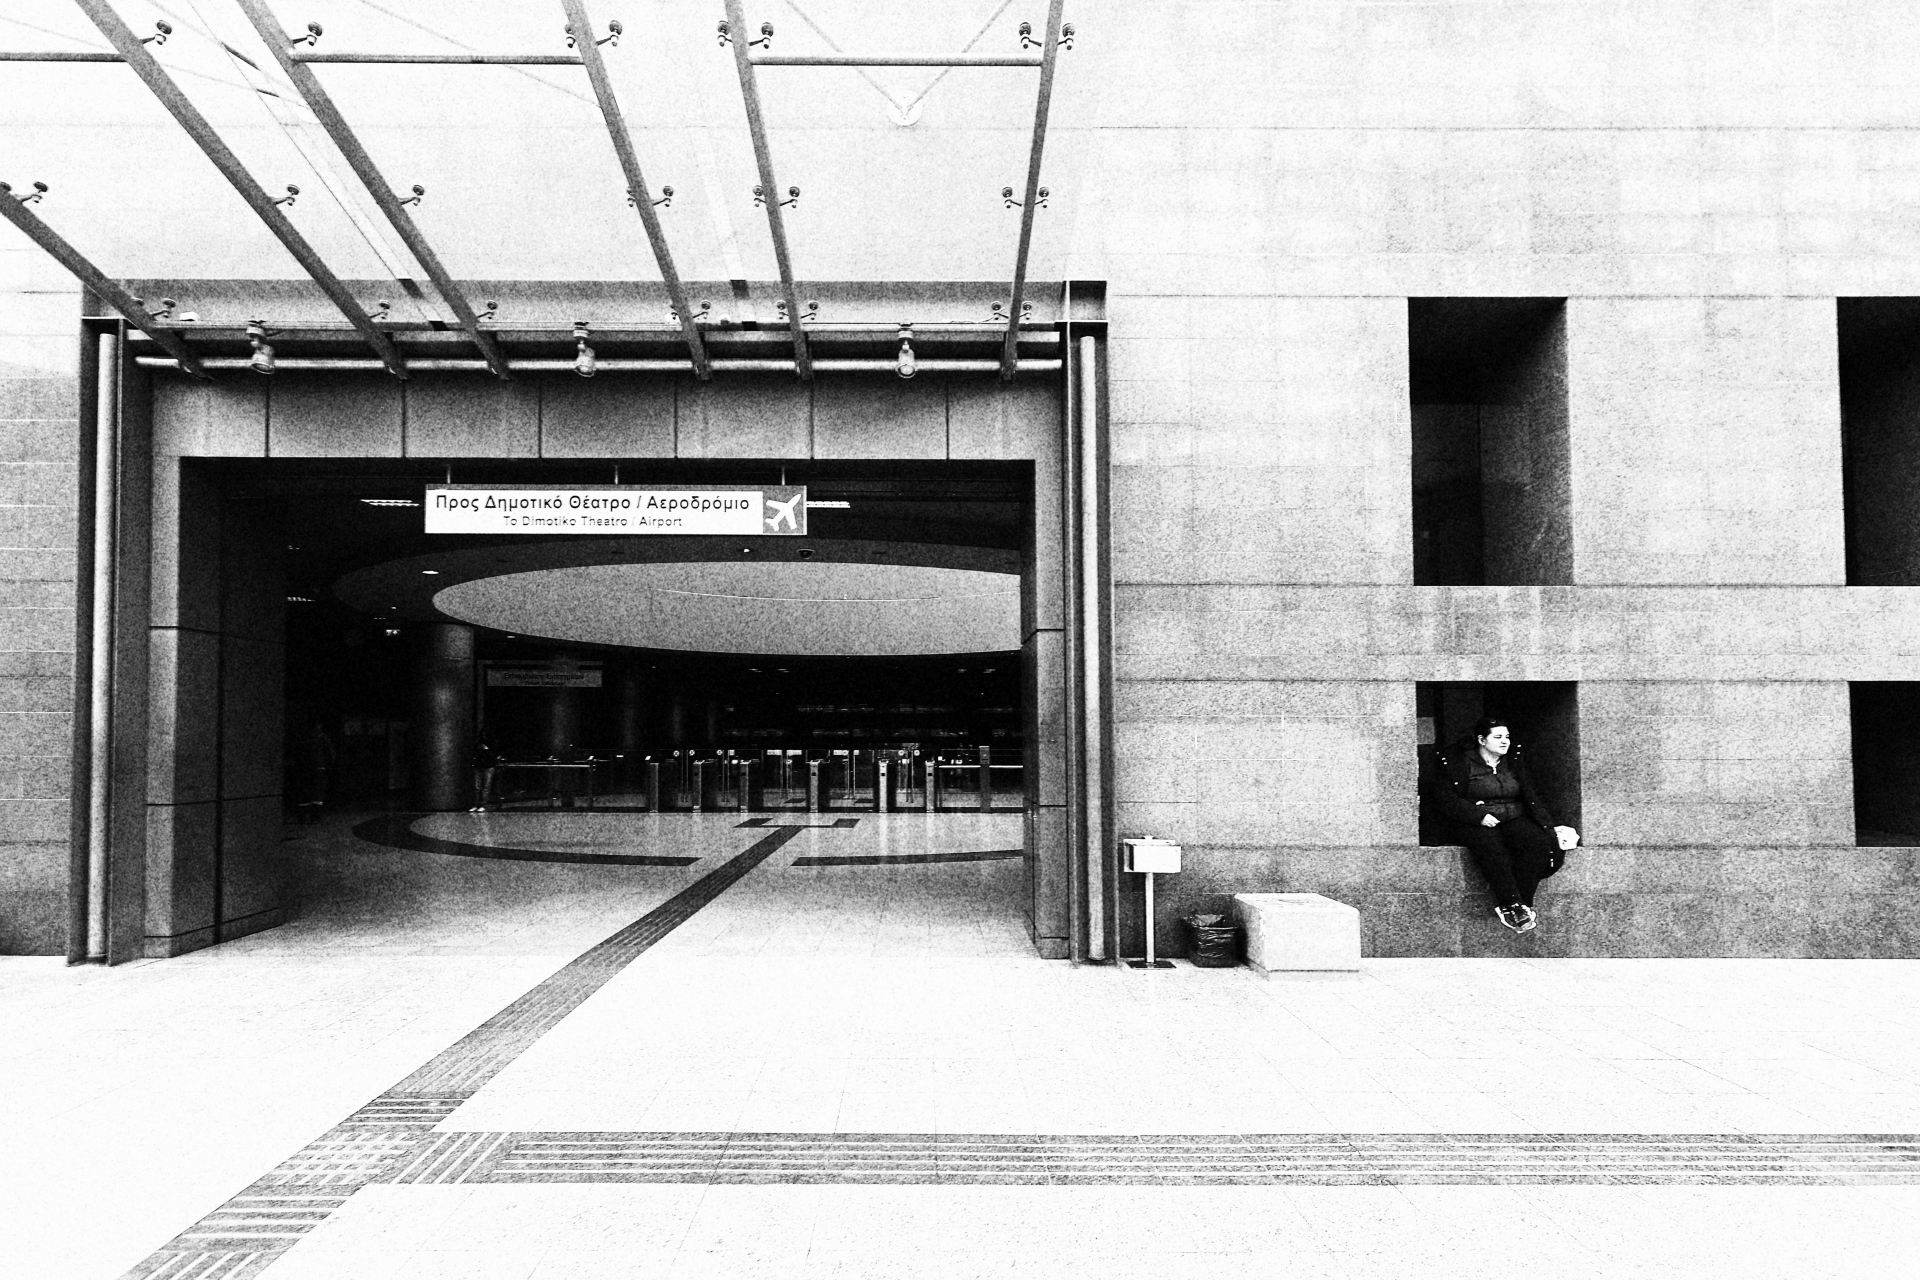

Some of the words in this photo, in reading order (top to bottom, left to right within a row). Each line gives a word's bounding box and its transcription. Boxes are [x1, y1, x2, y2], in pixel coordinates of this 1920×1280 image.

[436, 494, 480, 512] Προς
[484, 494, 563, 512] Δημοτικό
[569, 494, 631, 512] Θέατρο
[636, 495, 642, 509] /
[646, 495, 750, 512] Αεροδρόμιο
[503, 515, 518, 526] To
[522, 515, 577, 527] Dimotiko
[581, 515, 628, 527] Theatro
[638, 515, 683, 528] Airport
